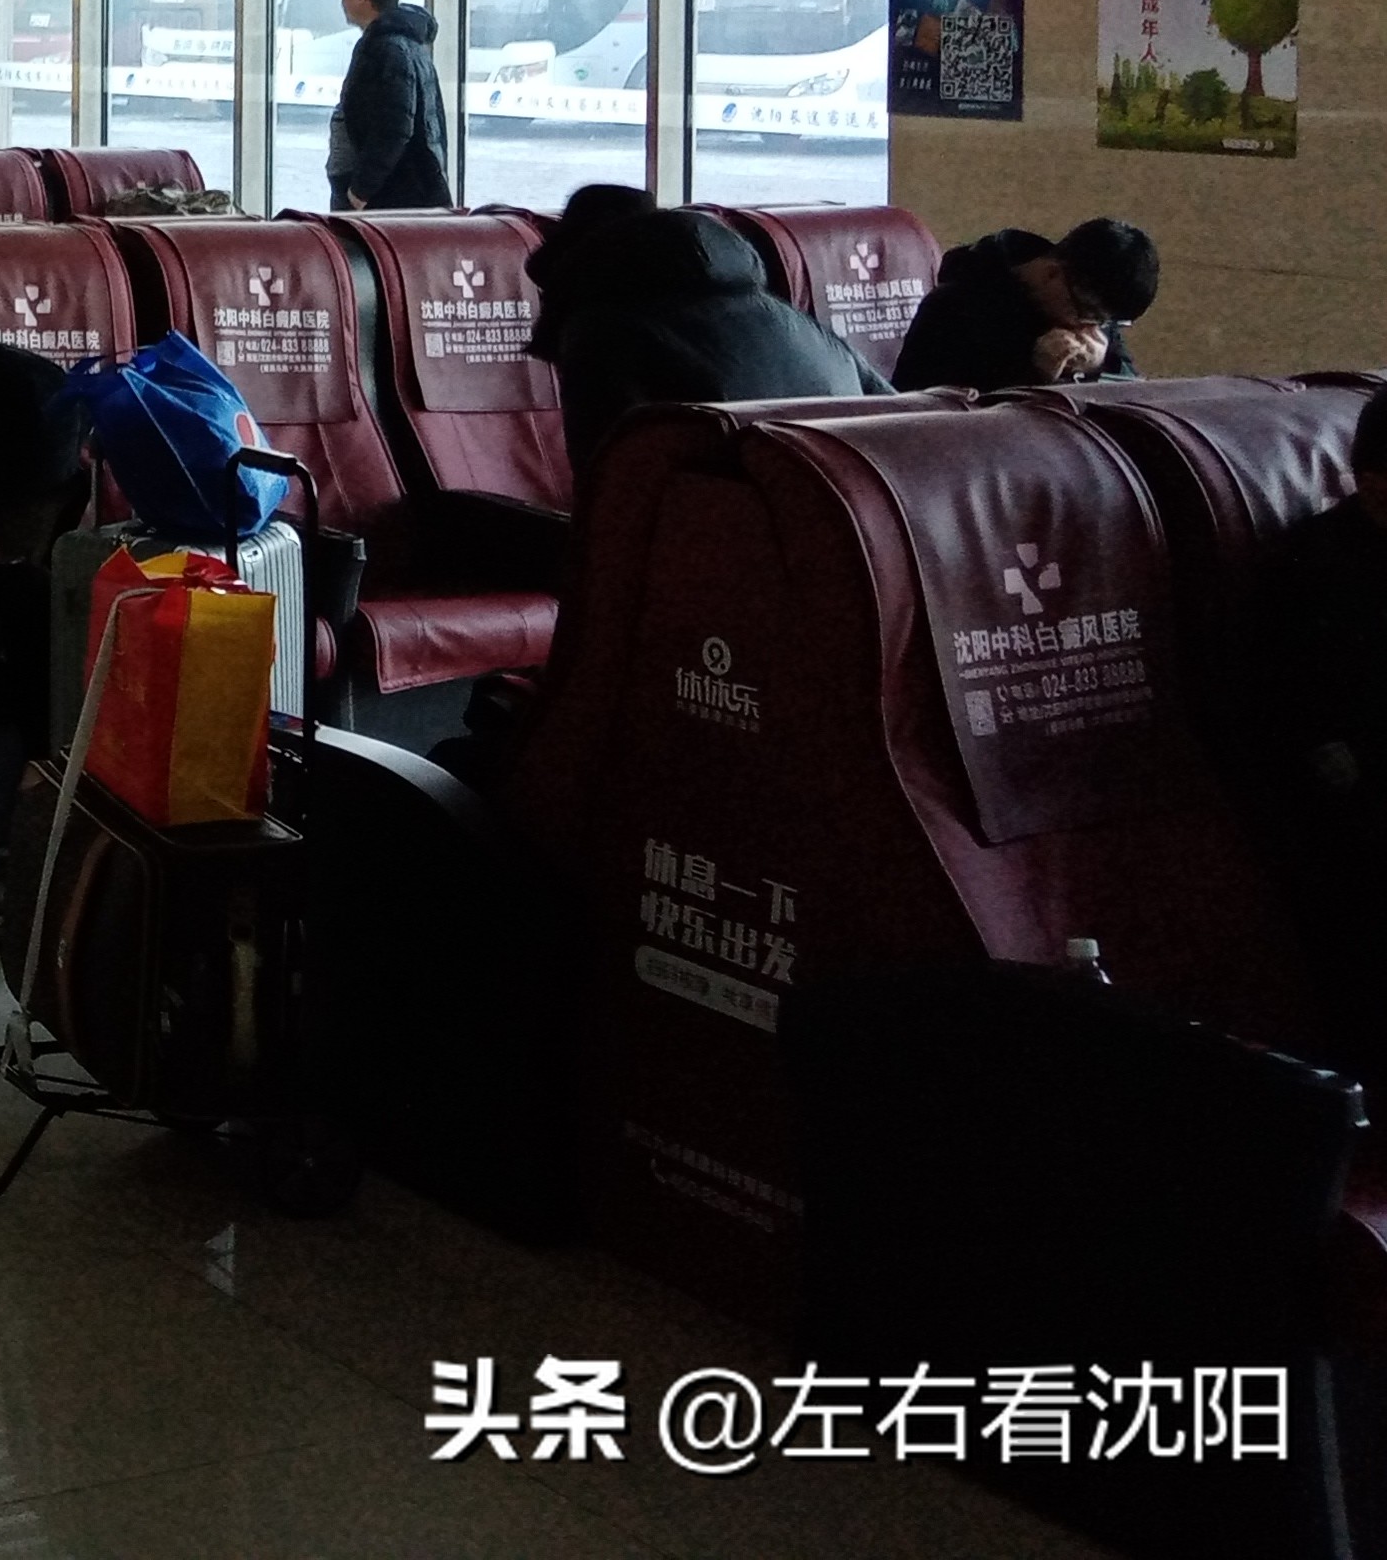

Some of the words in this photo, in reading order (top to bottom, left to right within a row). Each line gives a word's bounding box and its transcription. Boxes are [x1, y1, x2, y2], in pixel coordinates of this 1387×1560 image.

[953, 608, 1142, 665] 沈阳中科白癜风医院
[642, 836, 799, 926] 休息一下
[638, 890, 798, 986] 快乐出发
